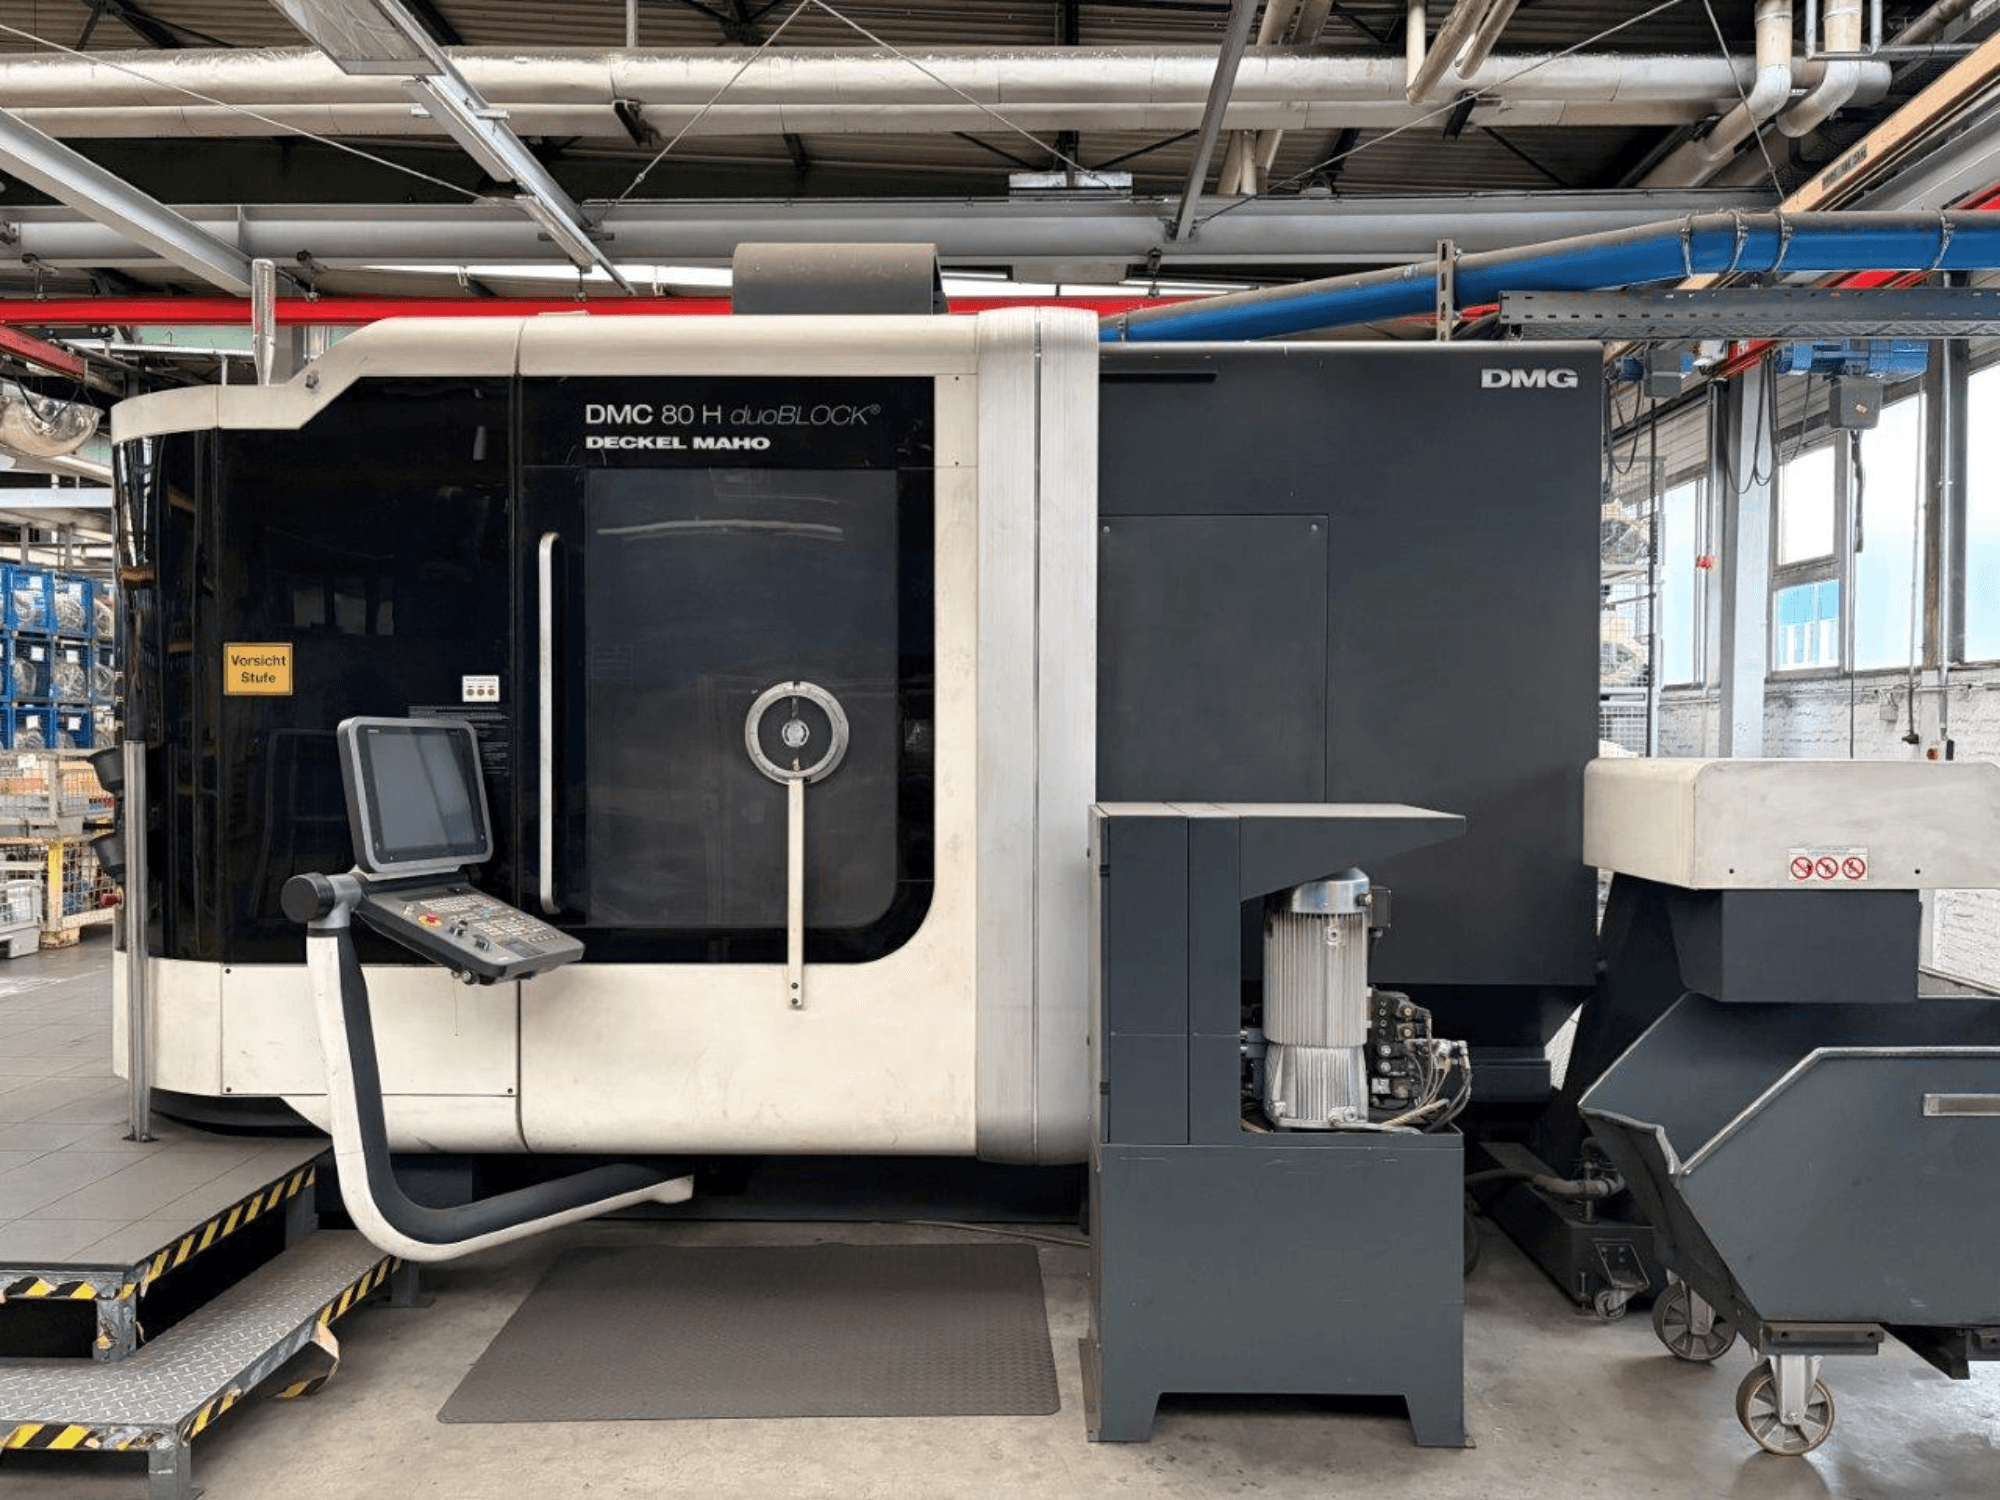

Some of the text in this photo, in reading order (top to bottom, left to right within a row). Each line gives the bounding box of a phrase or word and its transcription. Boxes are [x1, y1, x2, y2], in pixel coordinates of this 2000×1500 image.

[1481, 368, 1578, 388] DMG
[585, 404, 653, 424] DMC
[661, 404, 694, 424] 80
[702, 404, 722, 424] H
[585, 436, 771, 449] DECKEL MAHO
[231, 654, 286, 667] Vorsicht
[241, 671, 276, 684] Stufe
